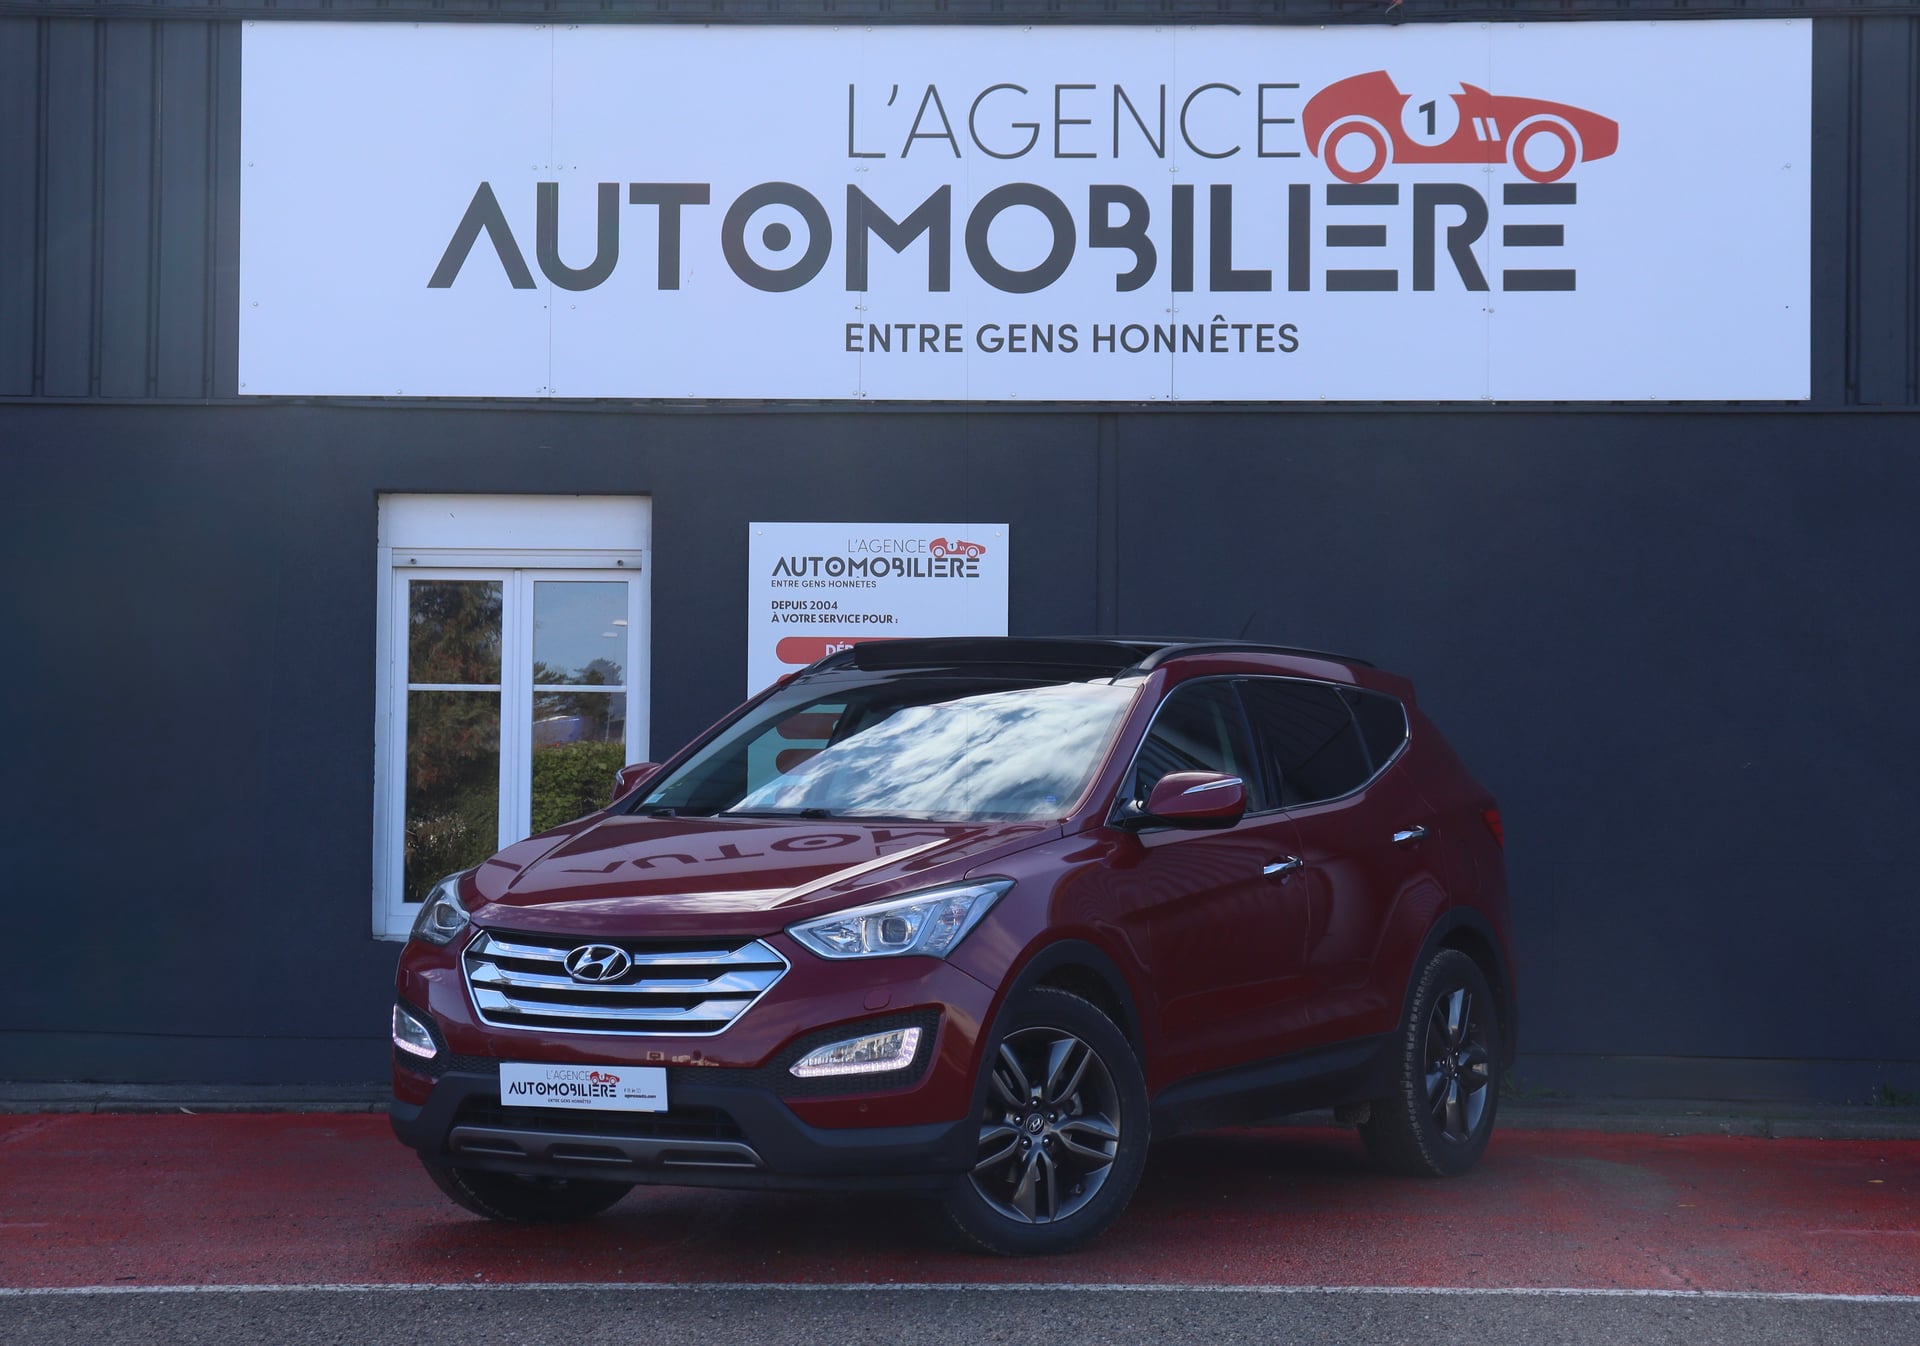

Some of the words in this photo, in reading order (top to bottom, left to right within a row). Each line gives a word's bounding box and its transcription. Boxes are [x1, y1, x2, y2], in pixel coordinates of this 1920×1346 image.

[848, 82, 1301, 160] L'AGENCE
[1418, 100, 1436, 136] 1
[845, 322, 964, 353] ENTRE
[976, 323, 1079, 353] GENS
[1093, 314, 1299, 354] HONNÊTES
[847, 538, 927, 554] L'AGENCE
[771, 579, 799, 588] ENTRE
[801, 580, 826, 588] GENS
[828, 576, 877, 589] HONNÊTES
[771, 600, 808, 610] DEPUIS
[809, 600, 839, 611] 2004
[771, 611, 780, 623] À
[781, 613, 817, 623] VOTRE
[818, 614, 861, 624] SERVICE
[862, 614, 894, 624] POUR
